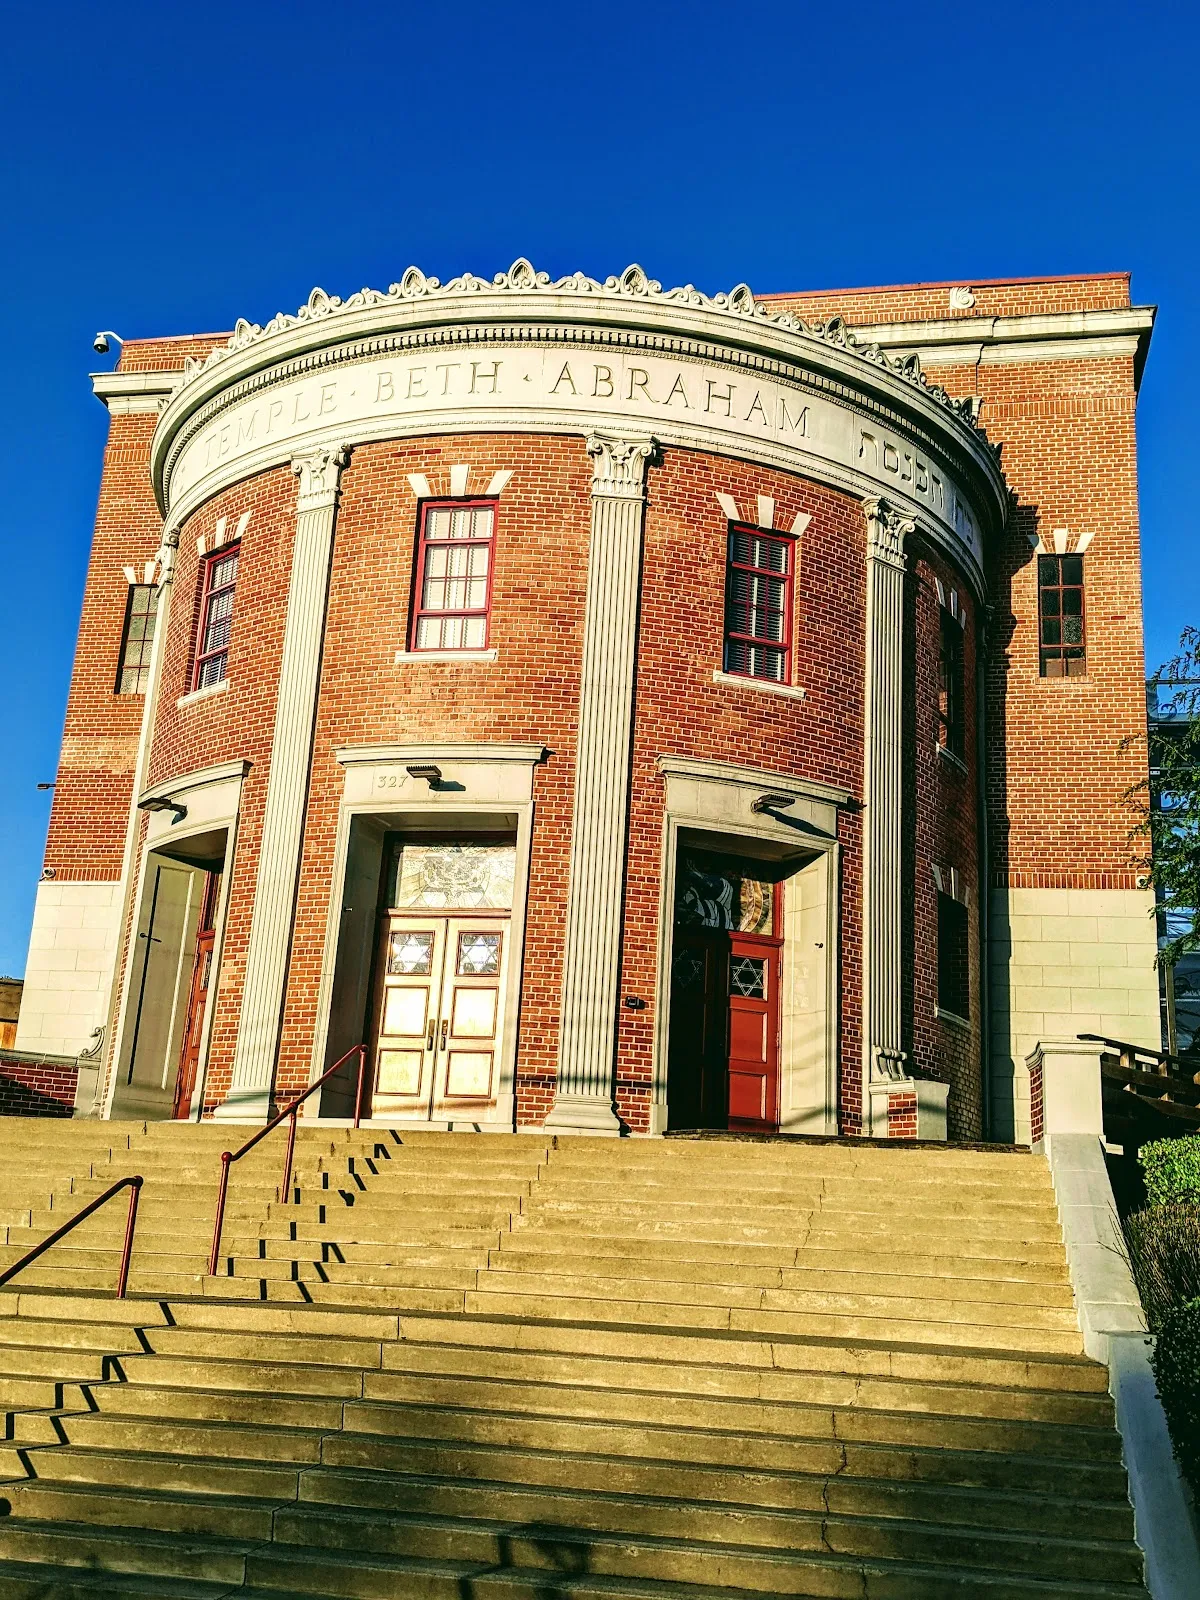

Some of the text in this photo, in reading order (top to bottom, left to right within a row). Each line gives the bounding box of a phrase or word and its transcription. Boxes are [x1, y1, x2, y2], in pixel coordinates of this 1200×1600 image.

[203, 360, 811, 468] TEMPLE BETH ABRAHAM
[377, 775, 409, 789] 327
